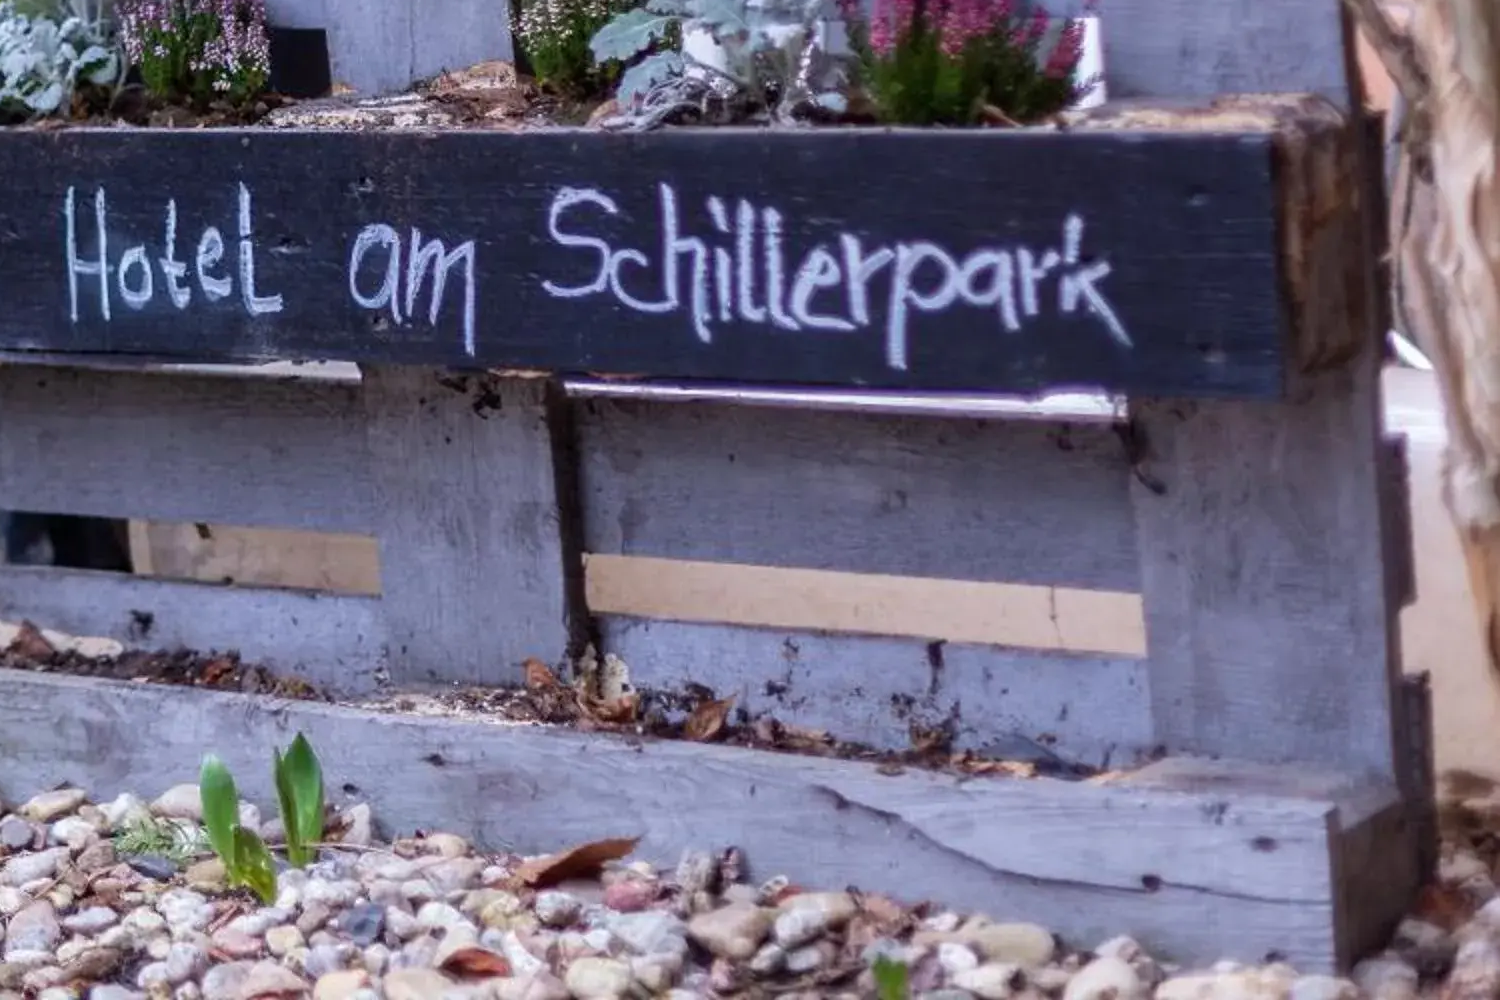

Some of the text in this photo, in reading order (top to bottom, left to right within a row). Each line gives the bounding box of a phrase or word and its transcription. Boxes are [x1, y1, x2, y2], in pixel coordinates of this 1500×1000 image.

[66, 181, 1134, 371] Hotel am Schillerpark
